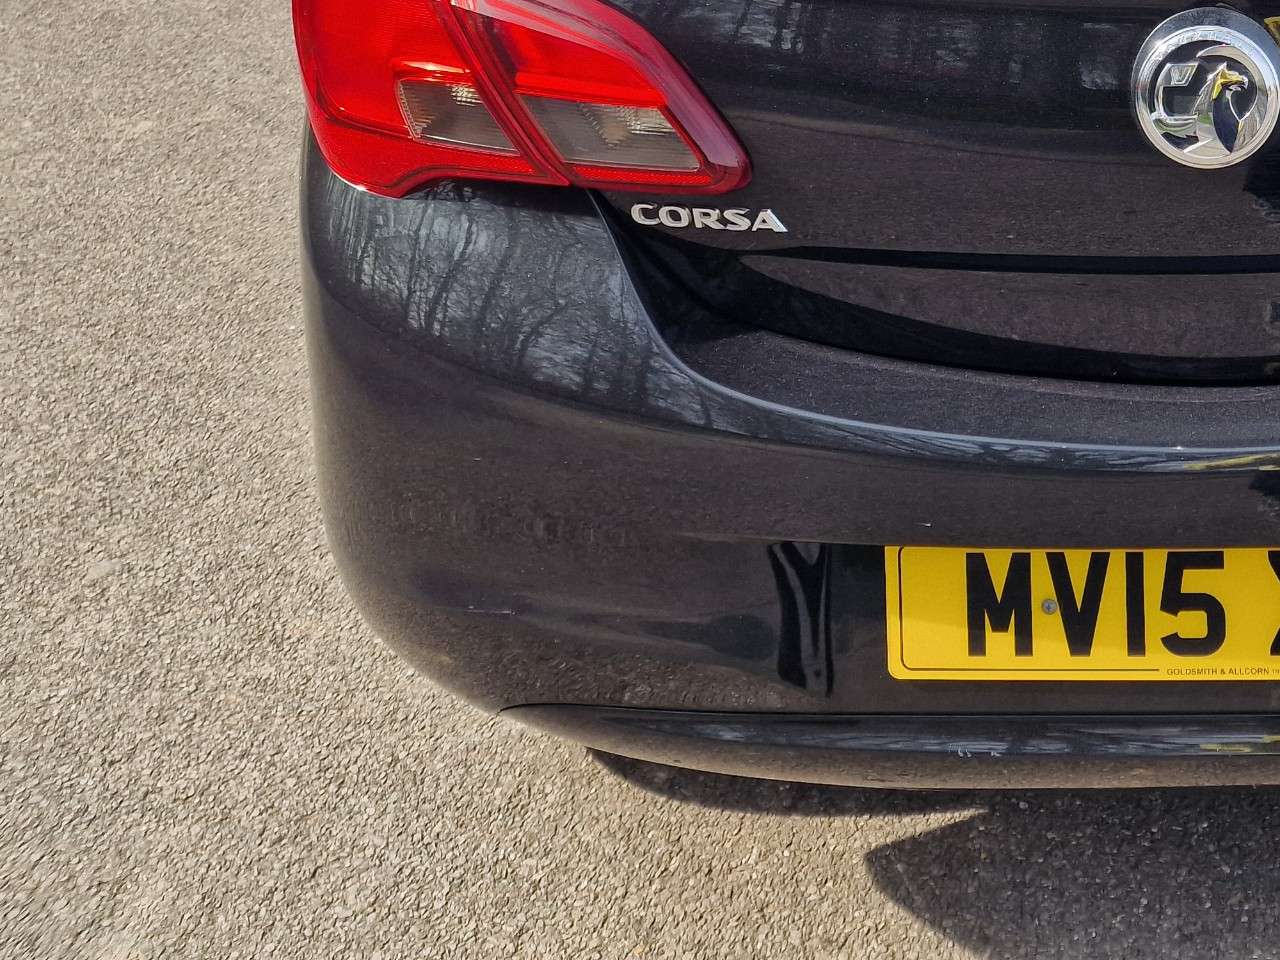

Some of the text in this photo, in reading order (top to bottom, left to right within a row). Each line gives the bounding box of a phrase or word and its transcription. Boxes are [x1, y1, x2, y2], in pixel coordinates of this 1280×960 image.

[630, 203, 788, 232] CORSA
[965, 550, 1226, 657] MV15
[1166, 667, 1217, 676] GOLDSMITH
[1219, 667, 1226, 676] &
[1228, 666, 1270, 676] ALLCORN
